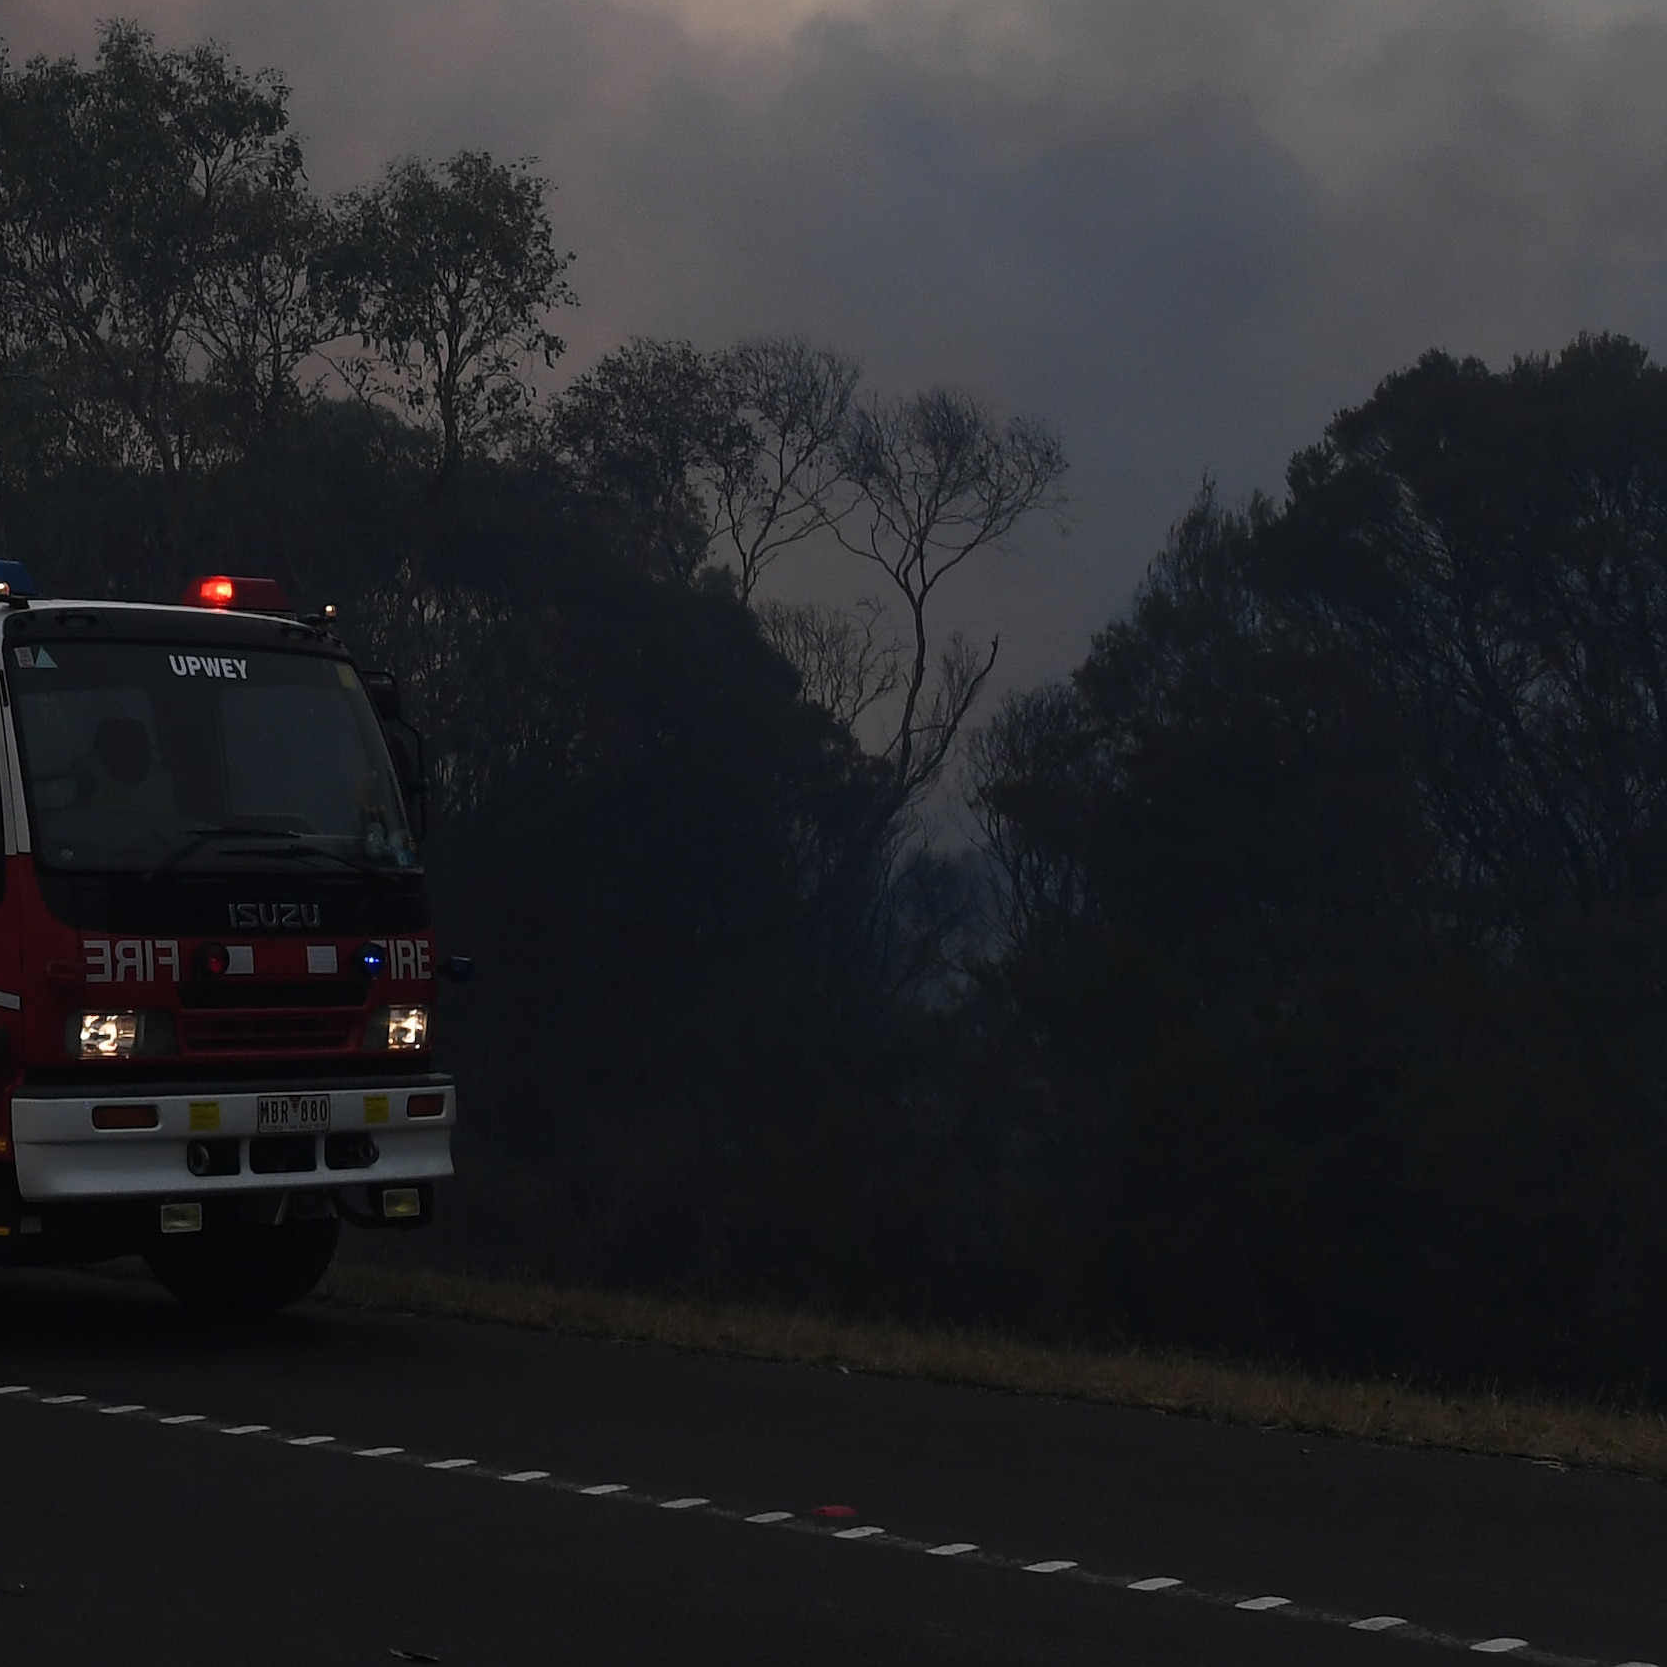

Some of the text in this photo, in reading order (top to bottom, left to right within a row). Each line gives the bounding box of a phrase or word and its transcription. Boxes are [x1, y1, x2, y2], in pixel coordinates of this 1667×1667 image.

[168, 654, 249, 680] UPWEY
[228, 902, 320, 928] ISUZU
[260, 1100, 328, 1123] MBR 880
